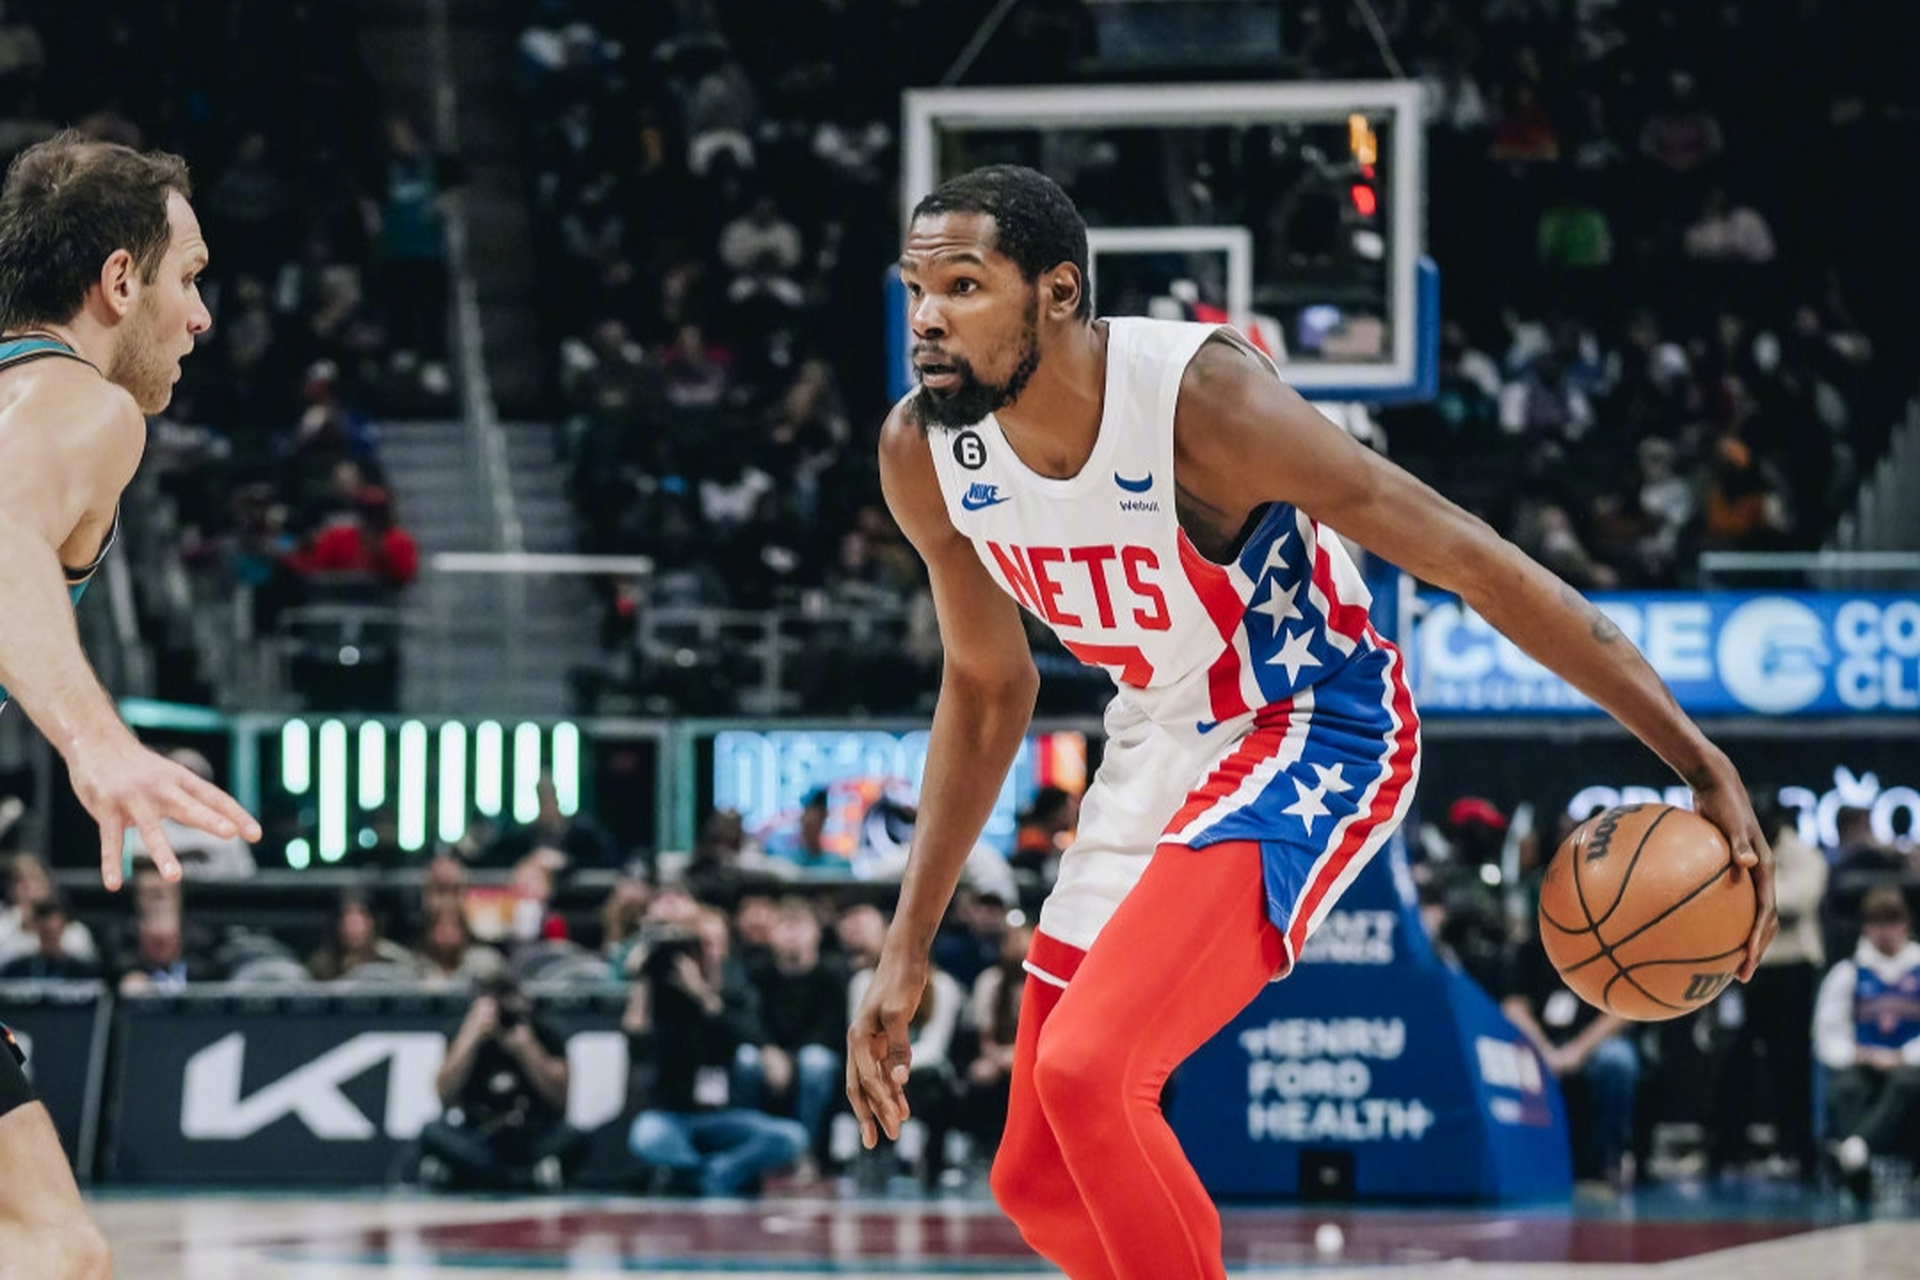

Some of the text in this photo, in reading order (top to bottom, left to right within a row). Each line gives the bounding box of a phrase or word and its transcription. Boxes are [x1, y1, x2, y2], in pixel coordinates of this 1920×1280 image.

[961, 436, 981, 466] 6
[969, 482, 999, 501] NIKE
[1119, 500, 1160, 512] Webull
[986, 540, 1172, 632] NETS
[1421, 600, 1713, 682] CE
[1239, 1017, 1406, 1060] HENRY
[1248, 1059, 1372, 1101] FORD
